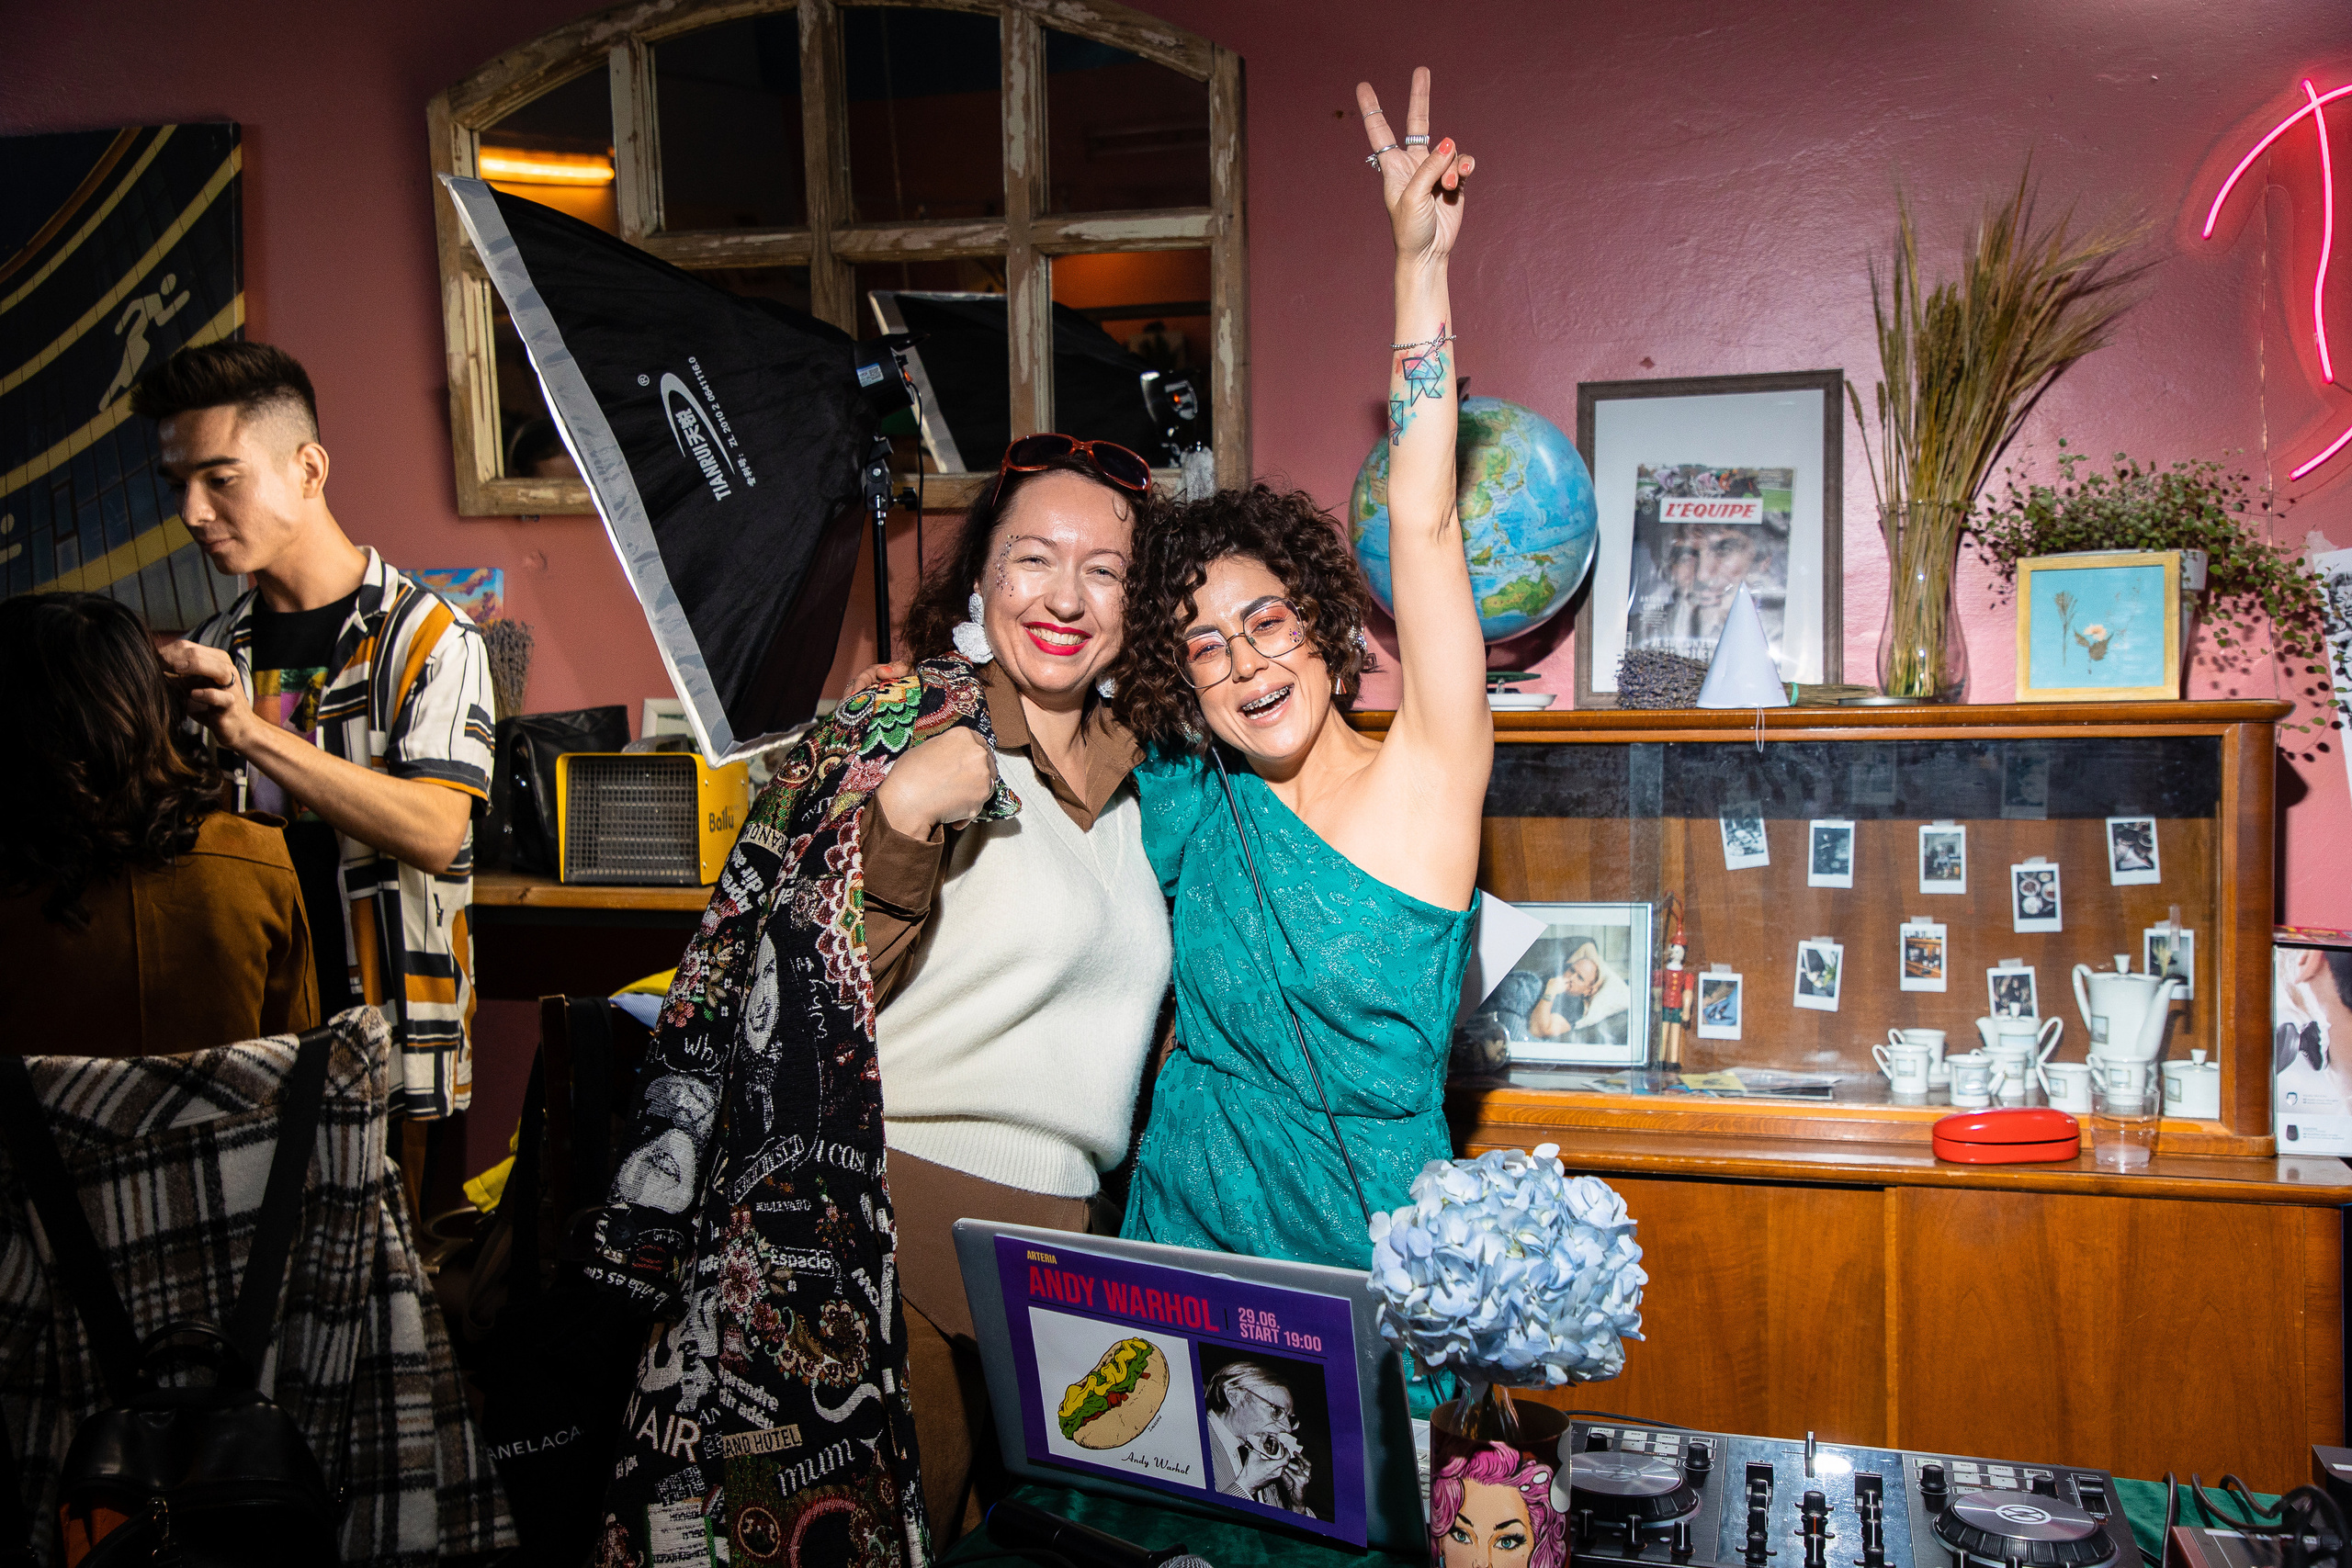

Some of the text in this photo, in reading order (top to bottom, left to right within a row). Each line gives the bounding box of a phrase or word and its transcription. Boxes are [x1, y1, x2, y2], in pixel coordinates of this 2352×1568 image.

[715, 411, 731, 434] 2010
[692, 443, 732, 502] TIANRUI
[708, 807, 734, 832] Ballu
[1027, 1250, 1057, 1264] ARTERIA
[1029, 1266, 1219, 1332] ANDY WARHOL
[1238, 1307, 1281, 1329] 29.06.
[1239, 1323, 1322, 1352] START 19:00
[1121, 1451, 1190, 1474] Andy Warhol
